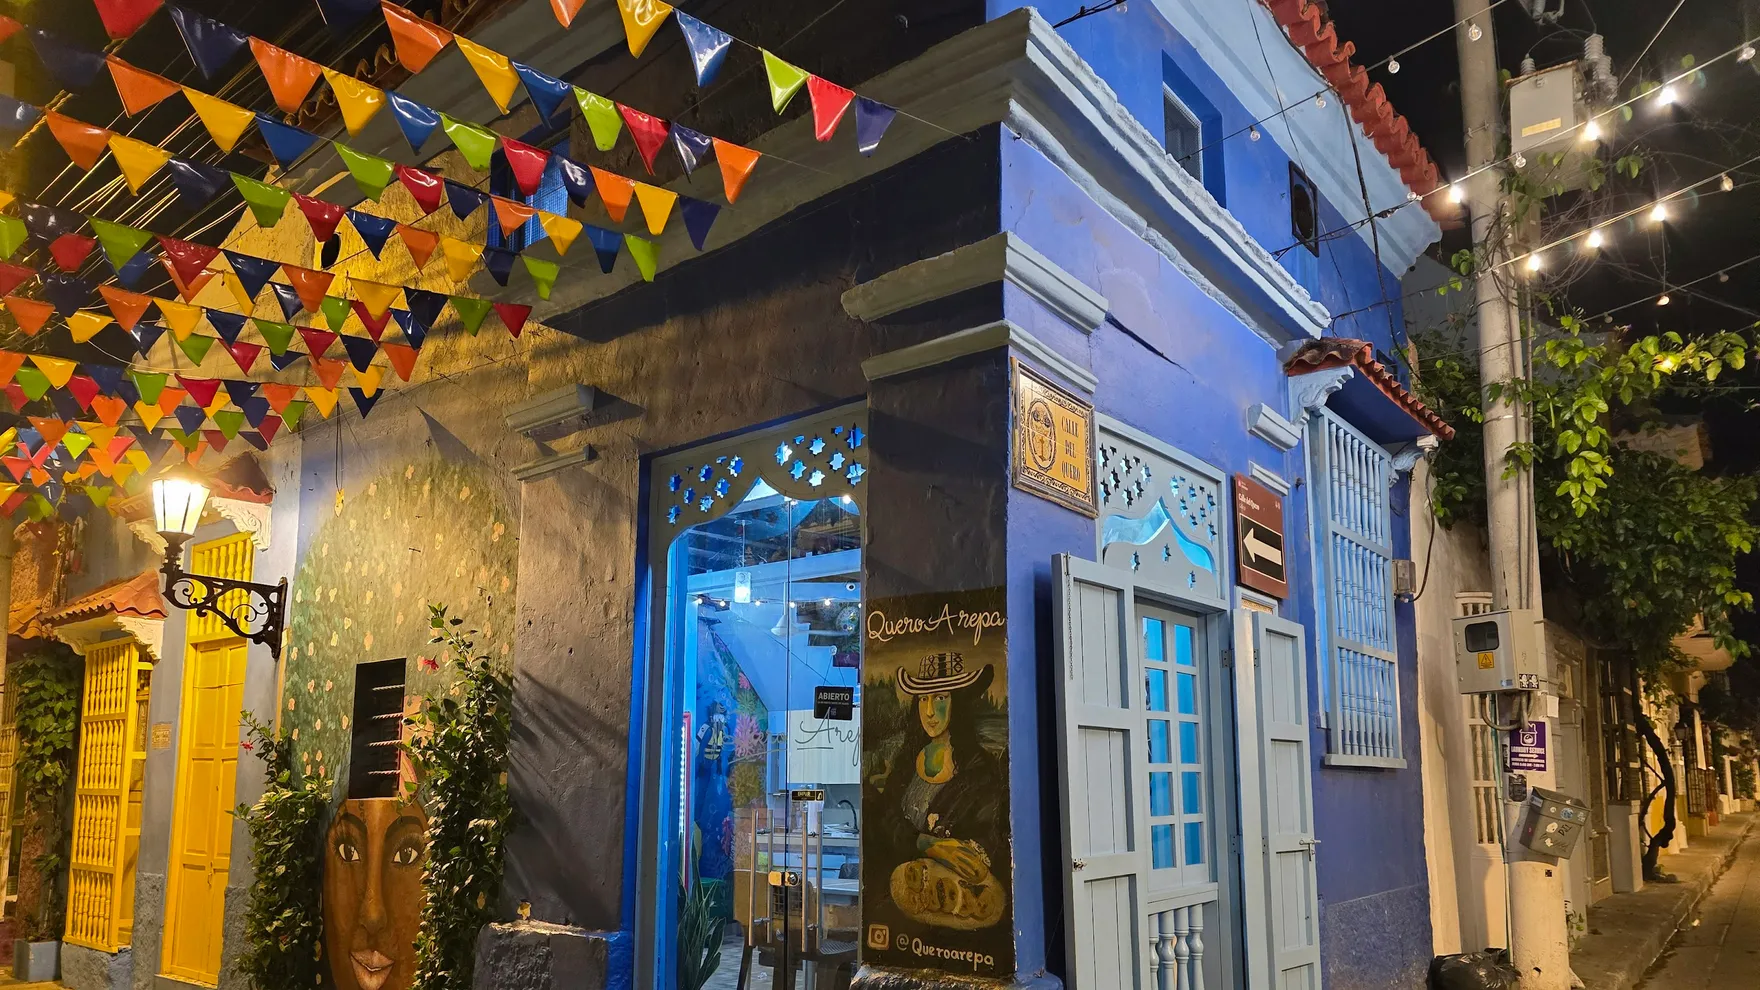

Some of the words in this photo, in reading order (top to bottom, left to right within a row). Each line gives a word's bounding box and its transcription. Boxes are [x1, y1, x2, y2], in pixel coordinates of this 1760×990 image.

[1061, 415, 1079, 438] CALLE
[1065, 439, 1077, 459] DEL
[1061, 460, 1081, 483] QUERO
[867, 610, 925, 642] Quero
[924, 603, 1005, 646] Arepa
[817, 692, 850, 701] ABIERTO
